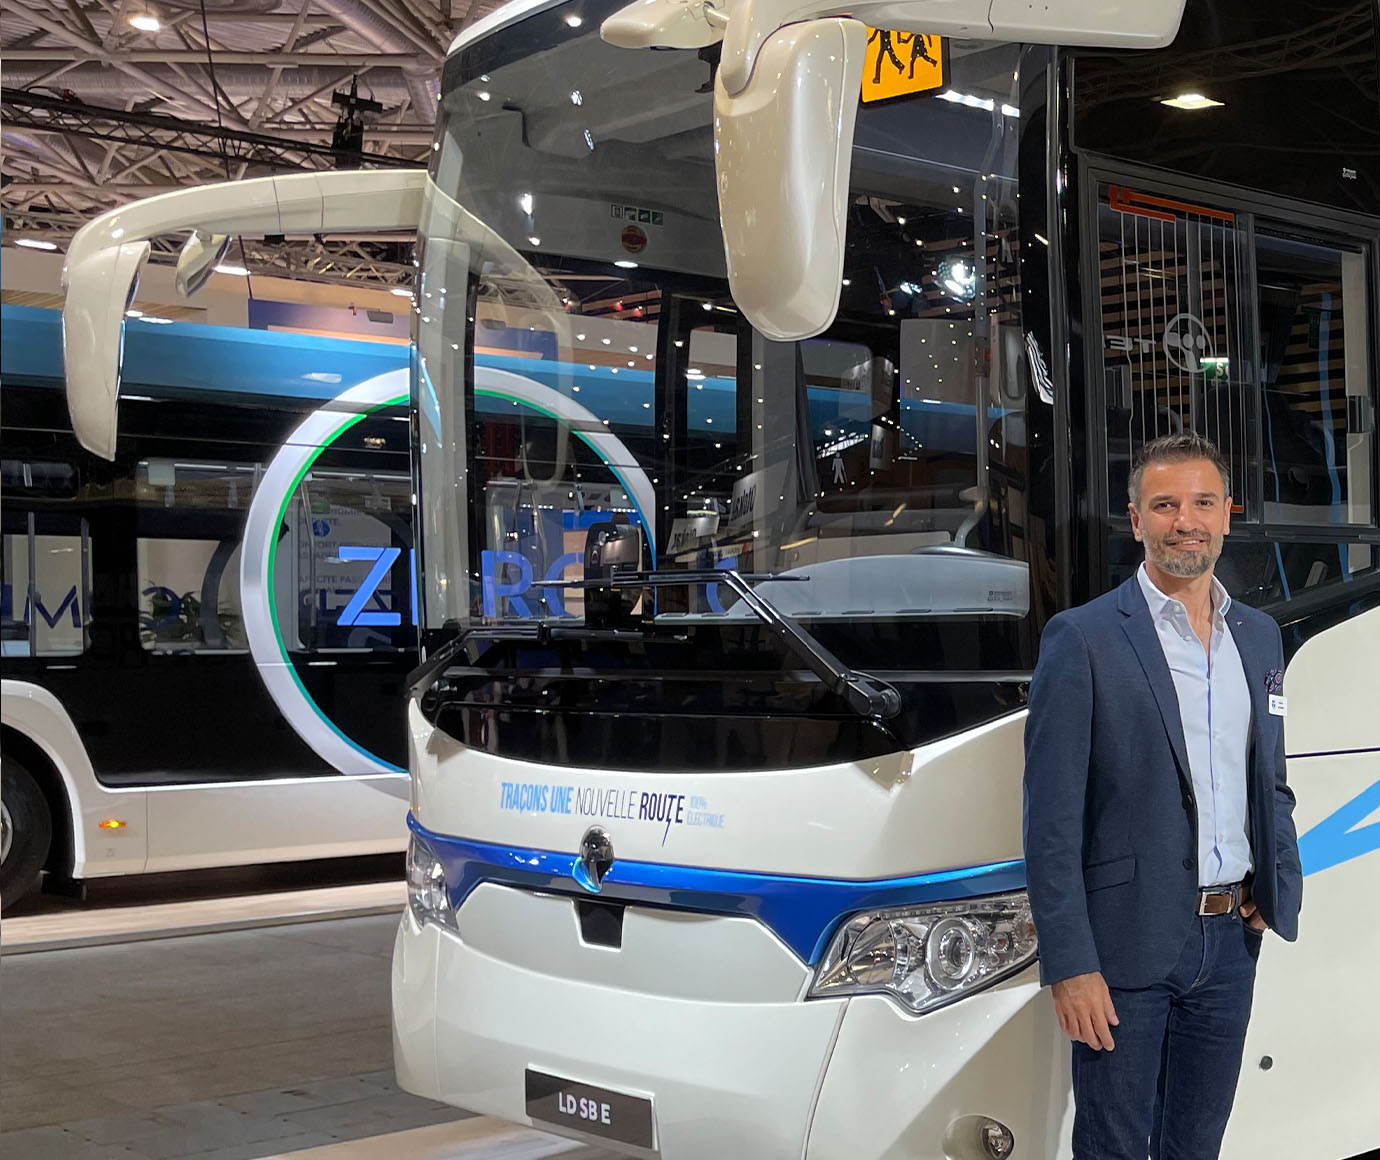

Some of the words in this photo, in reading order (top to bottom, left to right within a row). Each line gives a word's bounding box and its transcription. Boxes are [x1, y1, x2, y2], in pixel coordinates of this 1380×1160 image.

[500, 782, 548, 814] TRAÇONS
[550, 786, 574, 814] UNE
[575, 787, 637, 820] NOUVELLE
[639, 792, 685, 847] ROUTE
[559, 1091, 577, 1115] LD
[579, 1097, 598, 1120] SB
[600, 1103, 611, 1125] E
